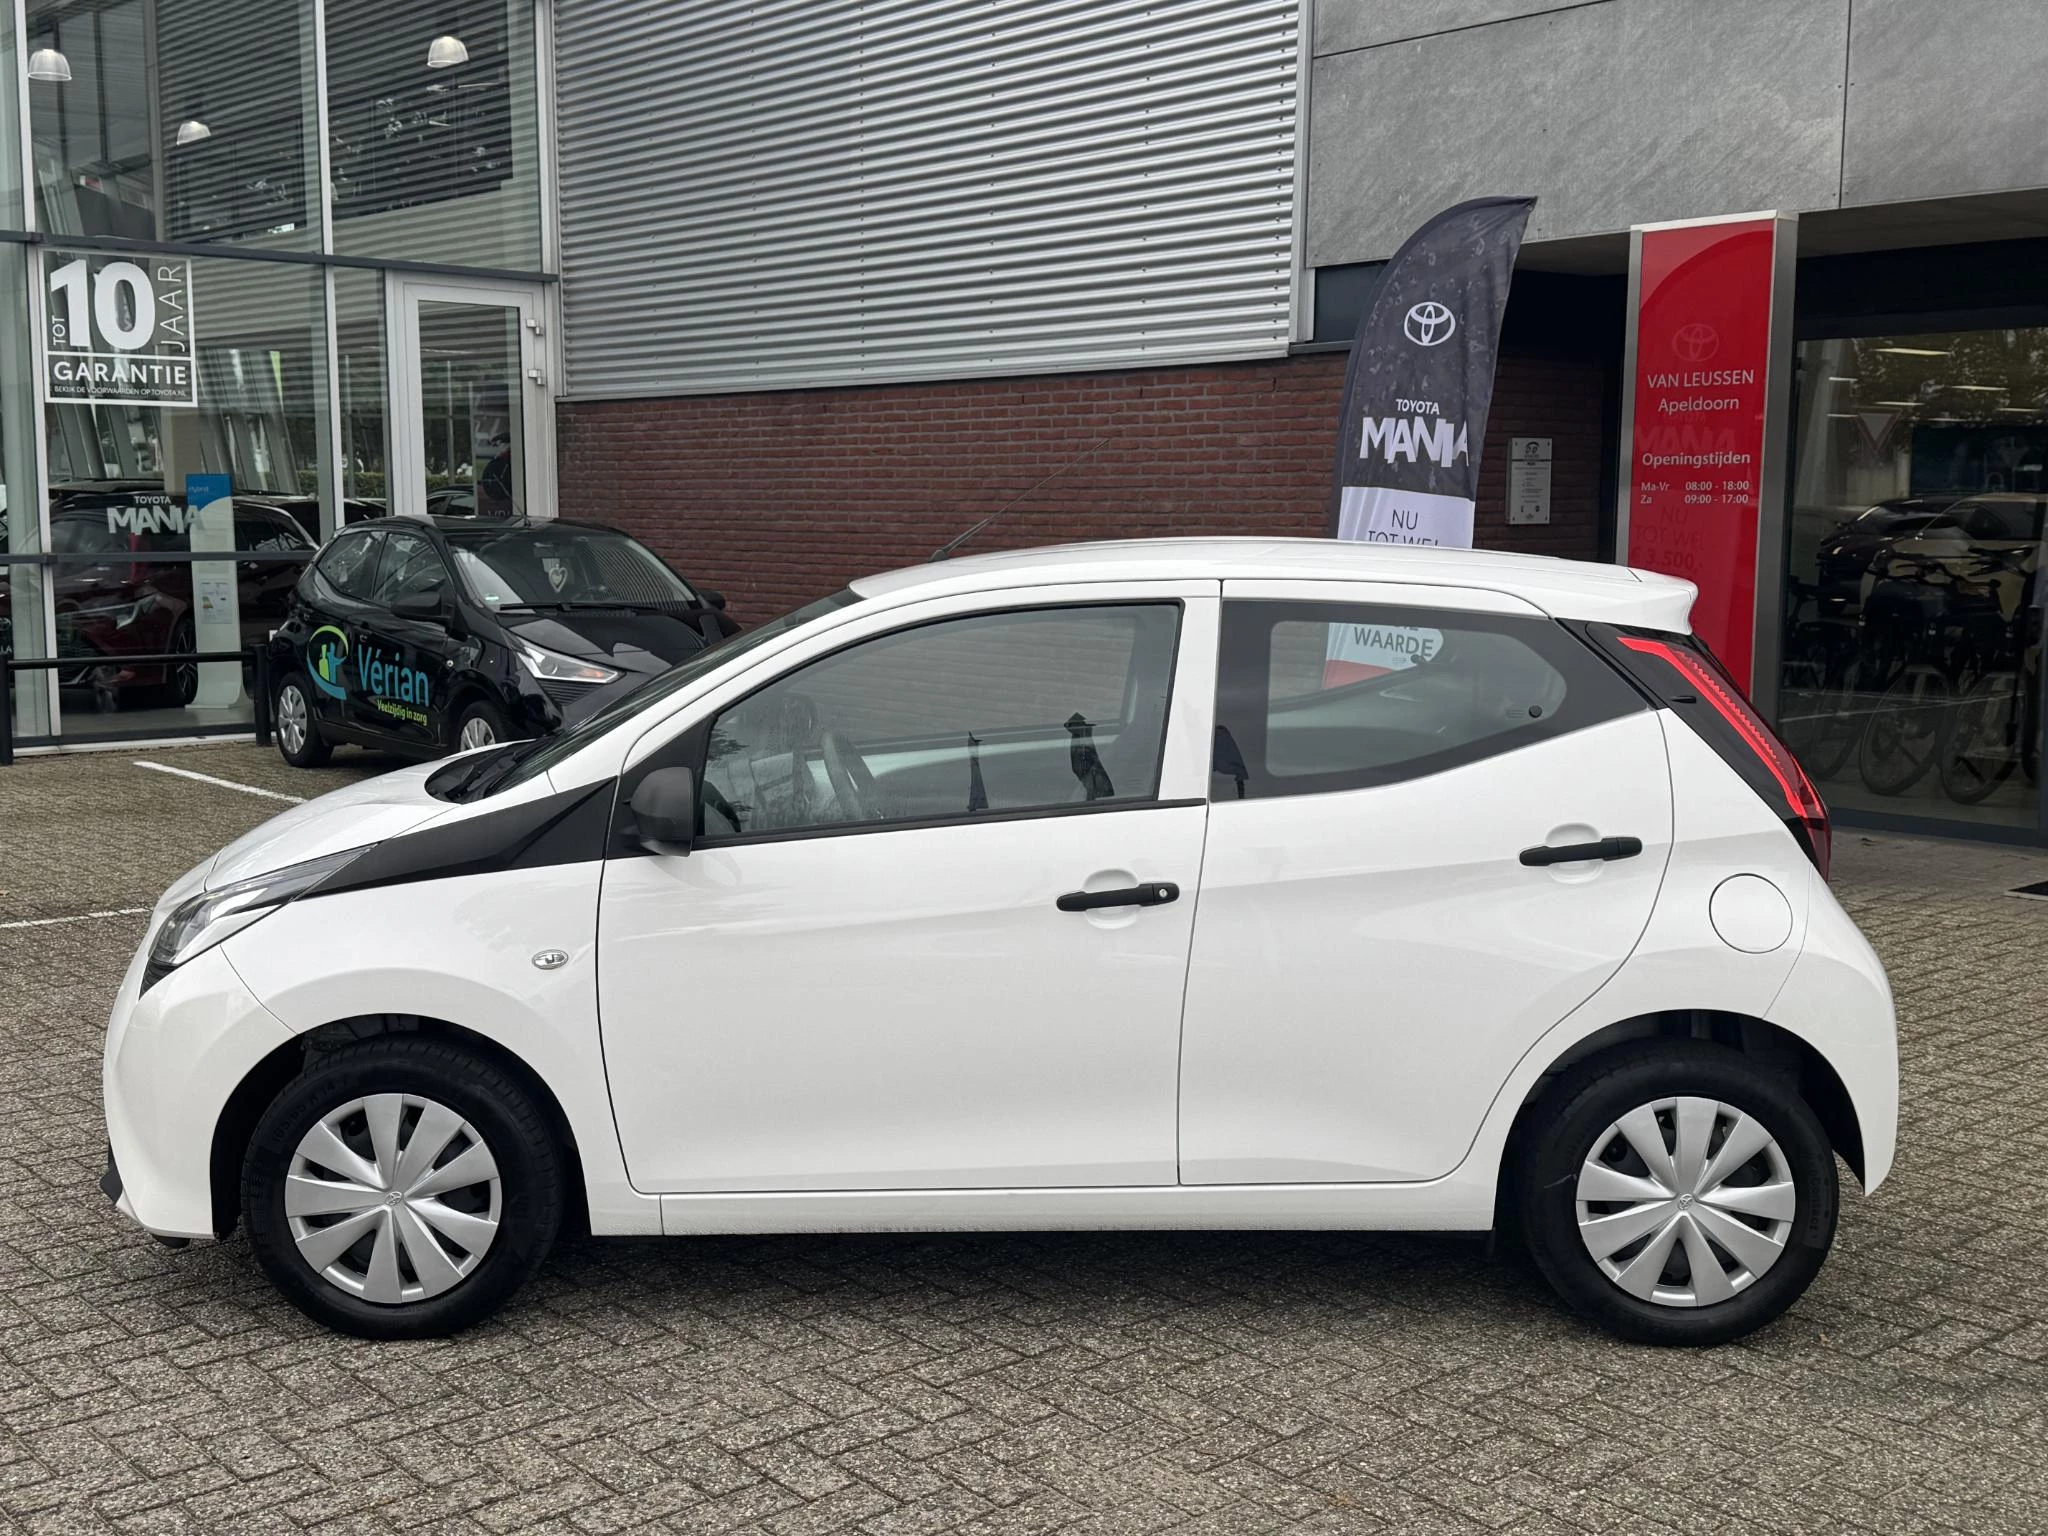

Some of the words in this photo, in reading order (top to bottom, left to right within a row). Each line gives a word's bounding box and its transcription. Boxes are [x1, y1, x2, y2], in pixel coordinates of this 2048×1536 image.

[50, 259, 156, 350] 10
[157, 265, 186, 352] JAAR
[52, 315, 66, 346] TOT
[53, 361, 187, 385] GARANTIE
[1647, 372, 1679, 389] VAN
[1683, 369, 1755, 388] LEUSSEN
[1396, 398, 1440, 415] TOYOTA
[1658, 397, 1740, 413] Apeldoorn
[1642, 452, 1751, 469] Openingstijden
[1641, 481, 1670, 491] Ma-Vr
[1685, 480, 1713, 491] 08:00
[1722, 480, 1750, 491] 18:00
[134, 496, 172, 504] TOYOTA
[1640, 494, 1653, 504] Za
[1684, 494, 1712, 504] 09:00
[1721, 494, 1749, 504] 17:00
[107, 505, 205, 536] MANIA
[1391, 509, 1419, 530] NU
[1353, 626, 1434, 658] WAARDE
[358, 643, 429, 707] Vérian
[413, 711, 428, 726] zorg
